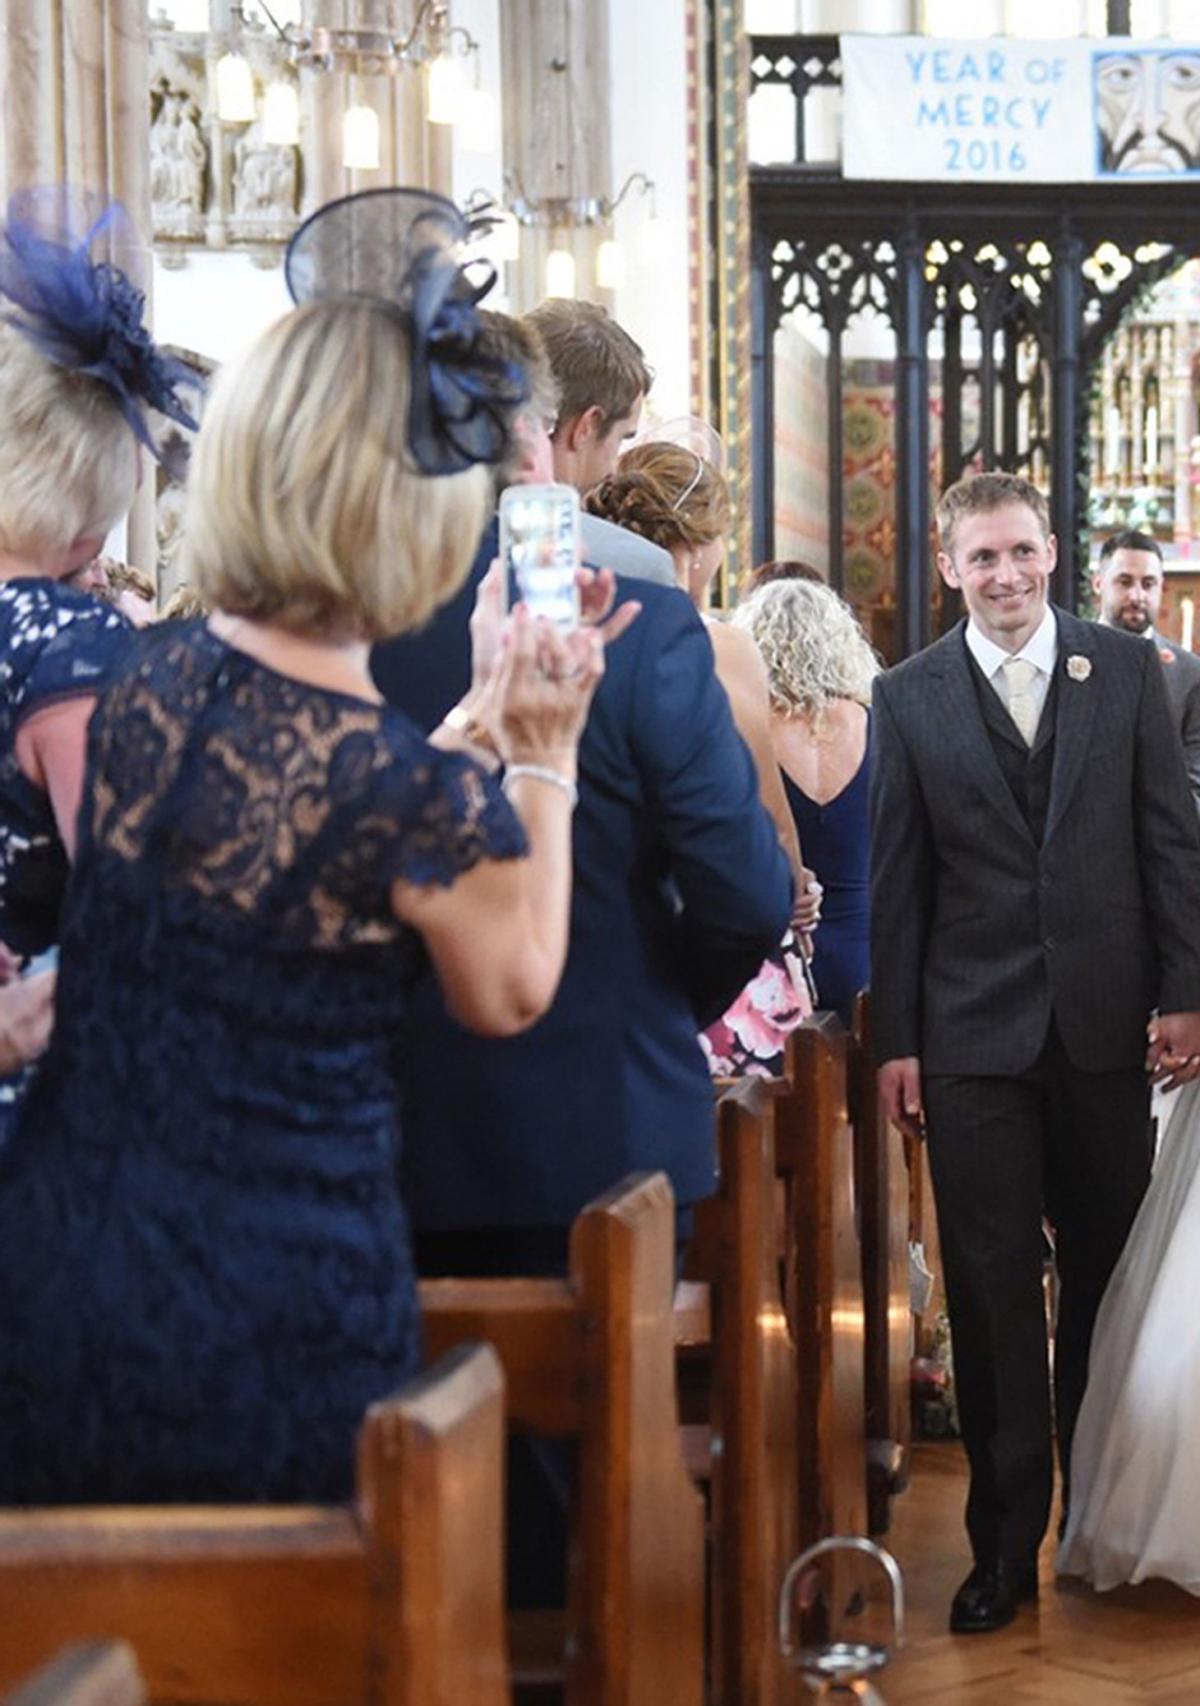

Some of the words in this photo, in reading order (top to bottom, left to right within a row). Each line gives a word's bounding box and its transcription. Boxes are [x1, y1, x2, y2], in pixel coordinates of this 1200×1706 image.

[905, 50, 1005, 83] YEAR
[1025, 59, 1067, 85] OF
[916, 94, 1052, 129] MERCY
[944, 138, 1027, 172] 2016
